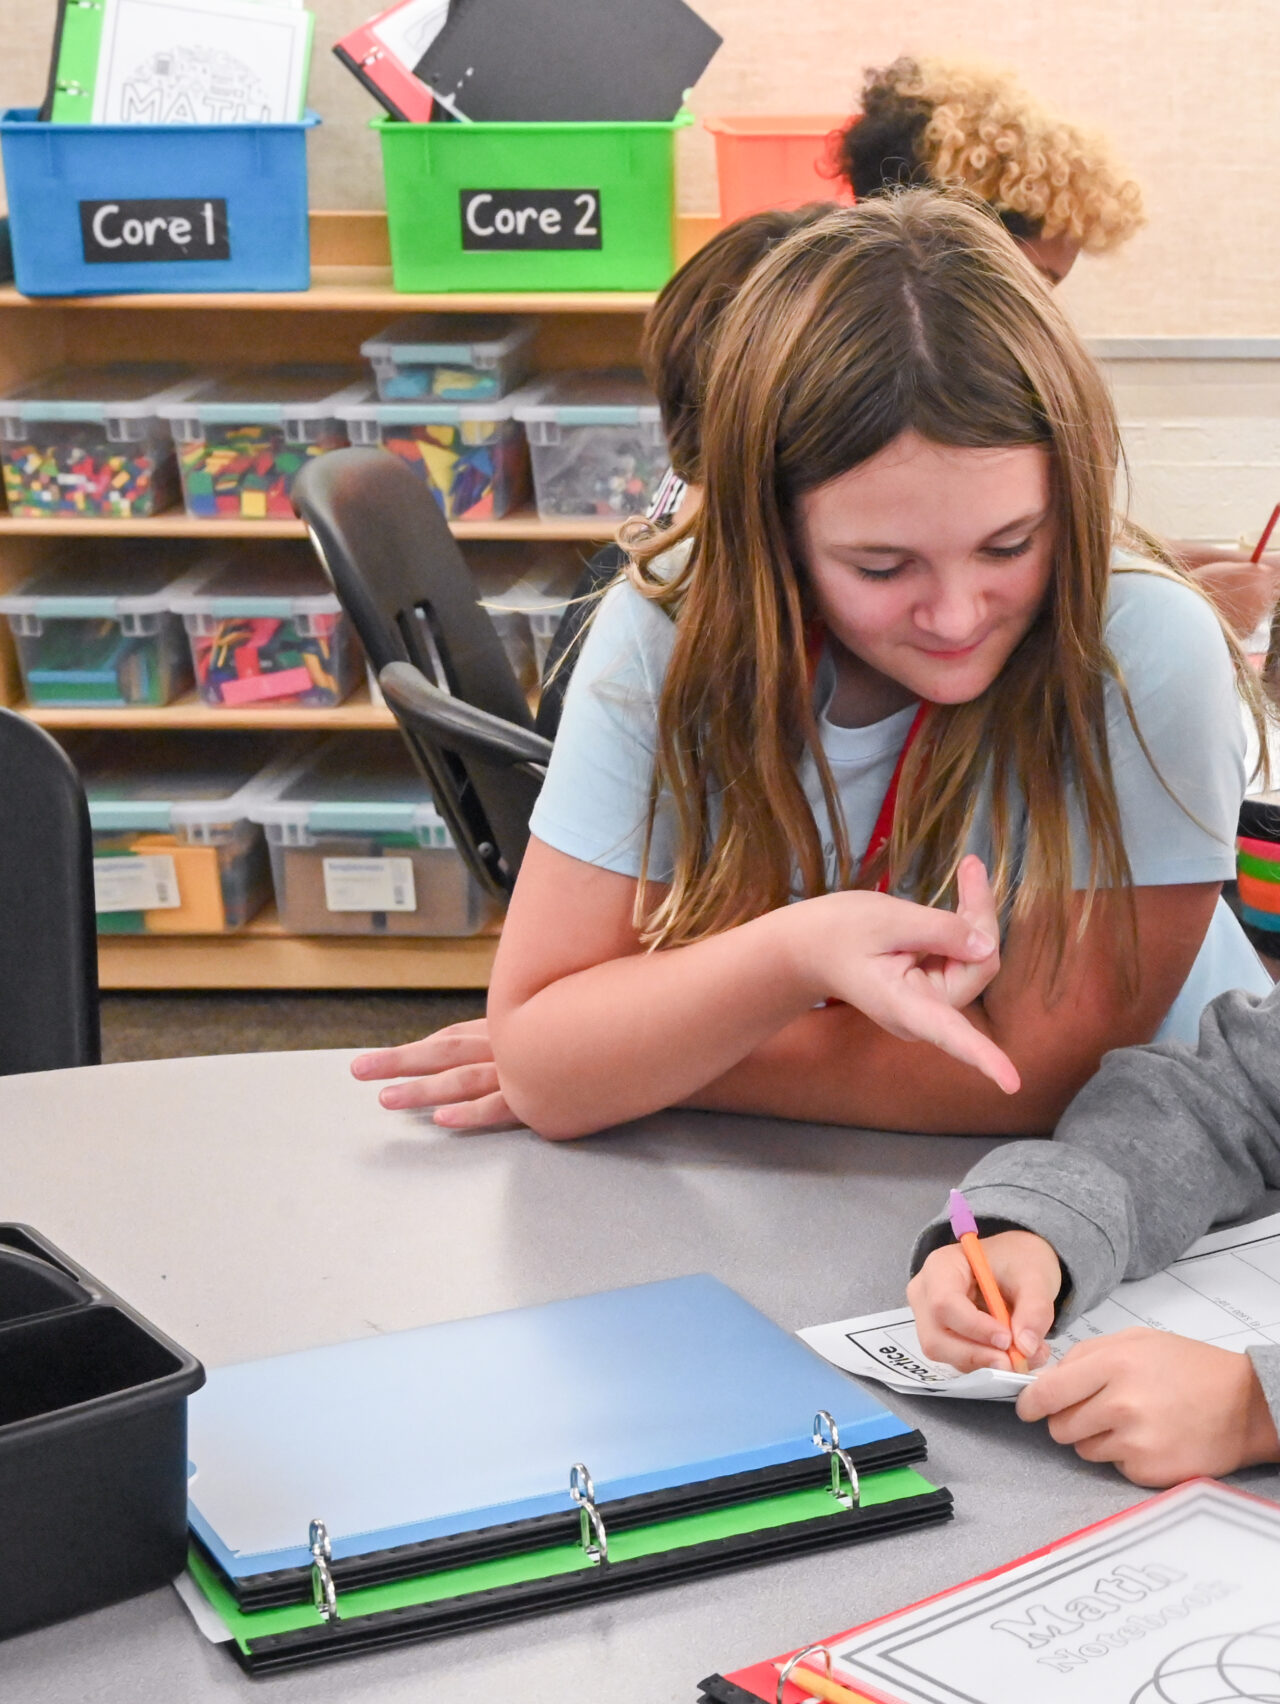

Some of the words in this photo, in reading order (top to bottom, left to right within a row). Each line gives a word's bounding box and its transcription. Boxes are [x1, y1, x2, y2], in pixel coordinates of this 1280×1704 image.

[120, 82, 271, 124] MATH
[92, 204, 192, 248] Core
[203, 202, 216, 246] 1
[466, 193, 562, 236] Core
[574, 193, 598, 236] 2
[878, 1345, 946, 1382] Practice
[989, 1563, 1189, 1650] Math
[1036, 1578, 1243, 1674] Notebook
